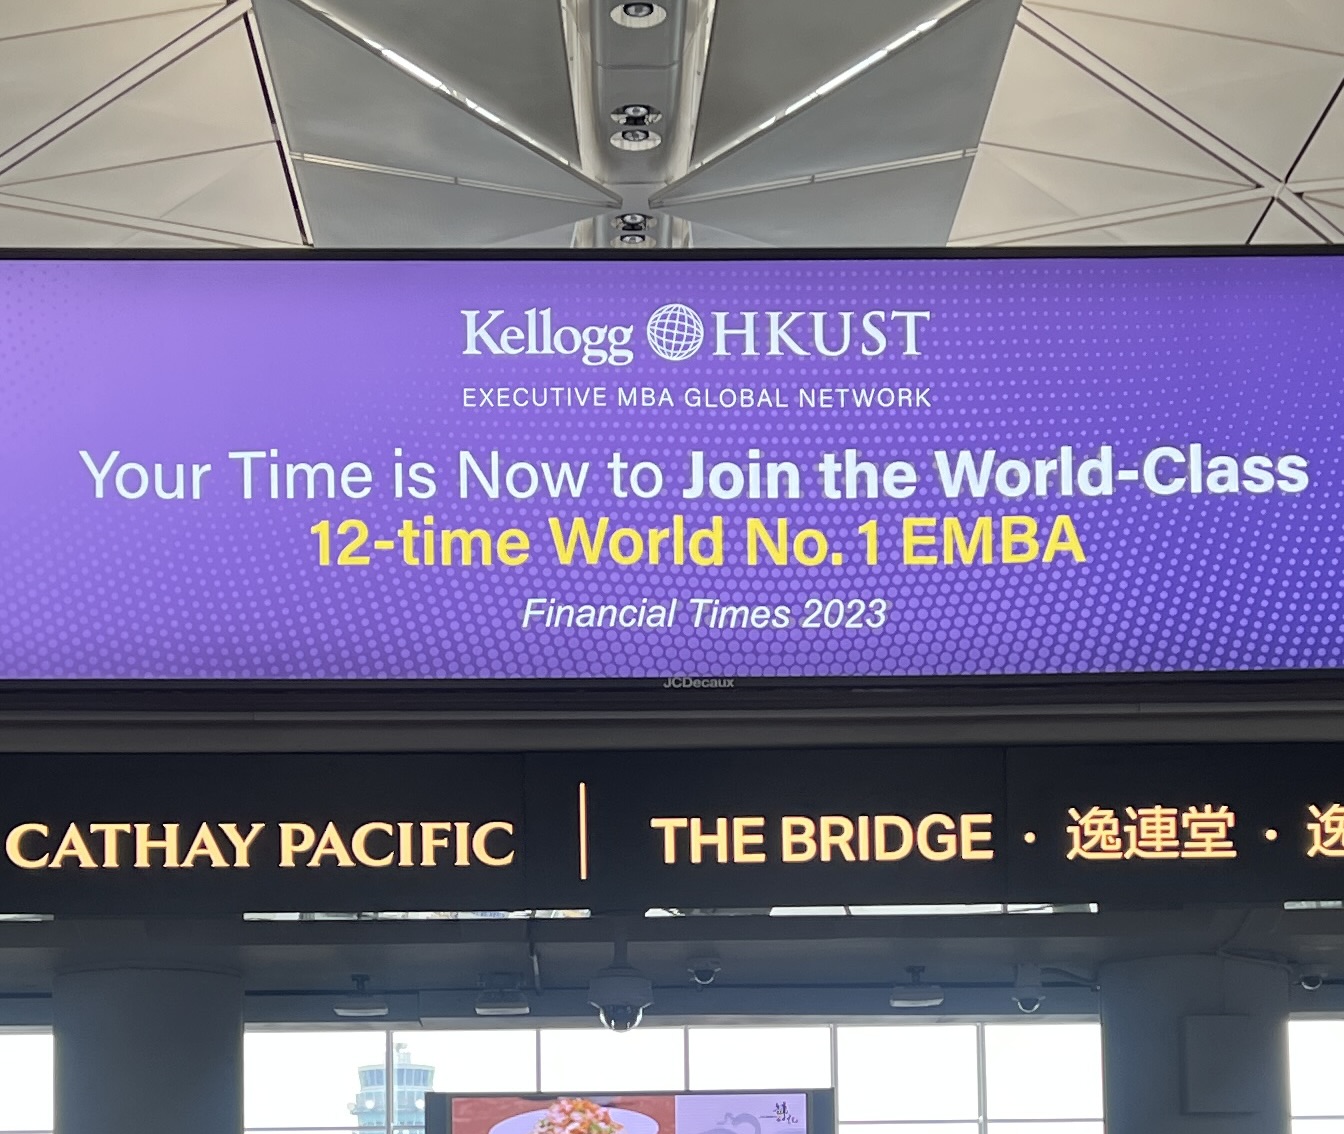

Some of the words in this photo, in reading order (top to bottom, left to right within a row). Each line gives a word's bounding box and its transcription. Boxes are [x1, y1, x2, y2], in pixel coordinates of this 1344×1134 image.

[460, 307, 634, 366] Kellogg
[711, 310, 931, 357] HKUST
[463, 387, 607, 407] EXECUTIVE
[618, 387, 674, 407] MBA
[684, 387, 789, 408] GLOBAL
[799, 387, 931, 408] NETWORK
[78, 450, 212, 500] Your
[228, 448, 373, 499] Time
[394, 447, 437, 499] is
[459, 450, 590, 499] Now
[607, 452, 663, 499] to
[682, 448, 800, 500] Join
[818, 448, 917, 500] the
[934, 443, 1309, 498] World-Class
[309, 516, 530, 565] 12-time
[549, 516, 724, 565] World
[747, 518, 843, 565] No.
[860, 521, 878, 564] 1
[903, 516, 1086, 564] EMBA
[522, 597, 679, 629] Financial
[689, 597, 792, 629] Times
[801, 597, 888, 629] 2023
[663, 677, 735, 689] JCDecaux
[5, 821, 266, 869] CATHAY
[278, 820, 515, 868] PACIFIC
[650, 816, 766, 864] THE
[780, 812, 994, 862] BRIDGE
[1065, 803, 1238, 861] 逸連堂
